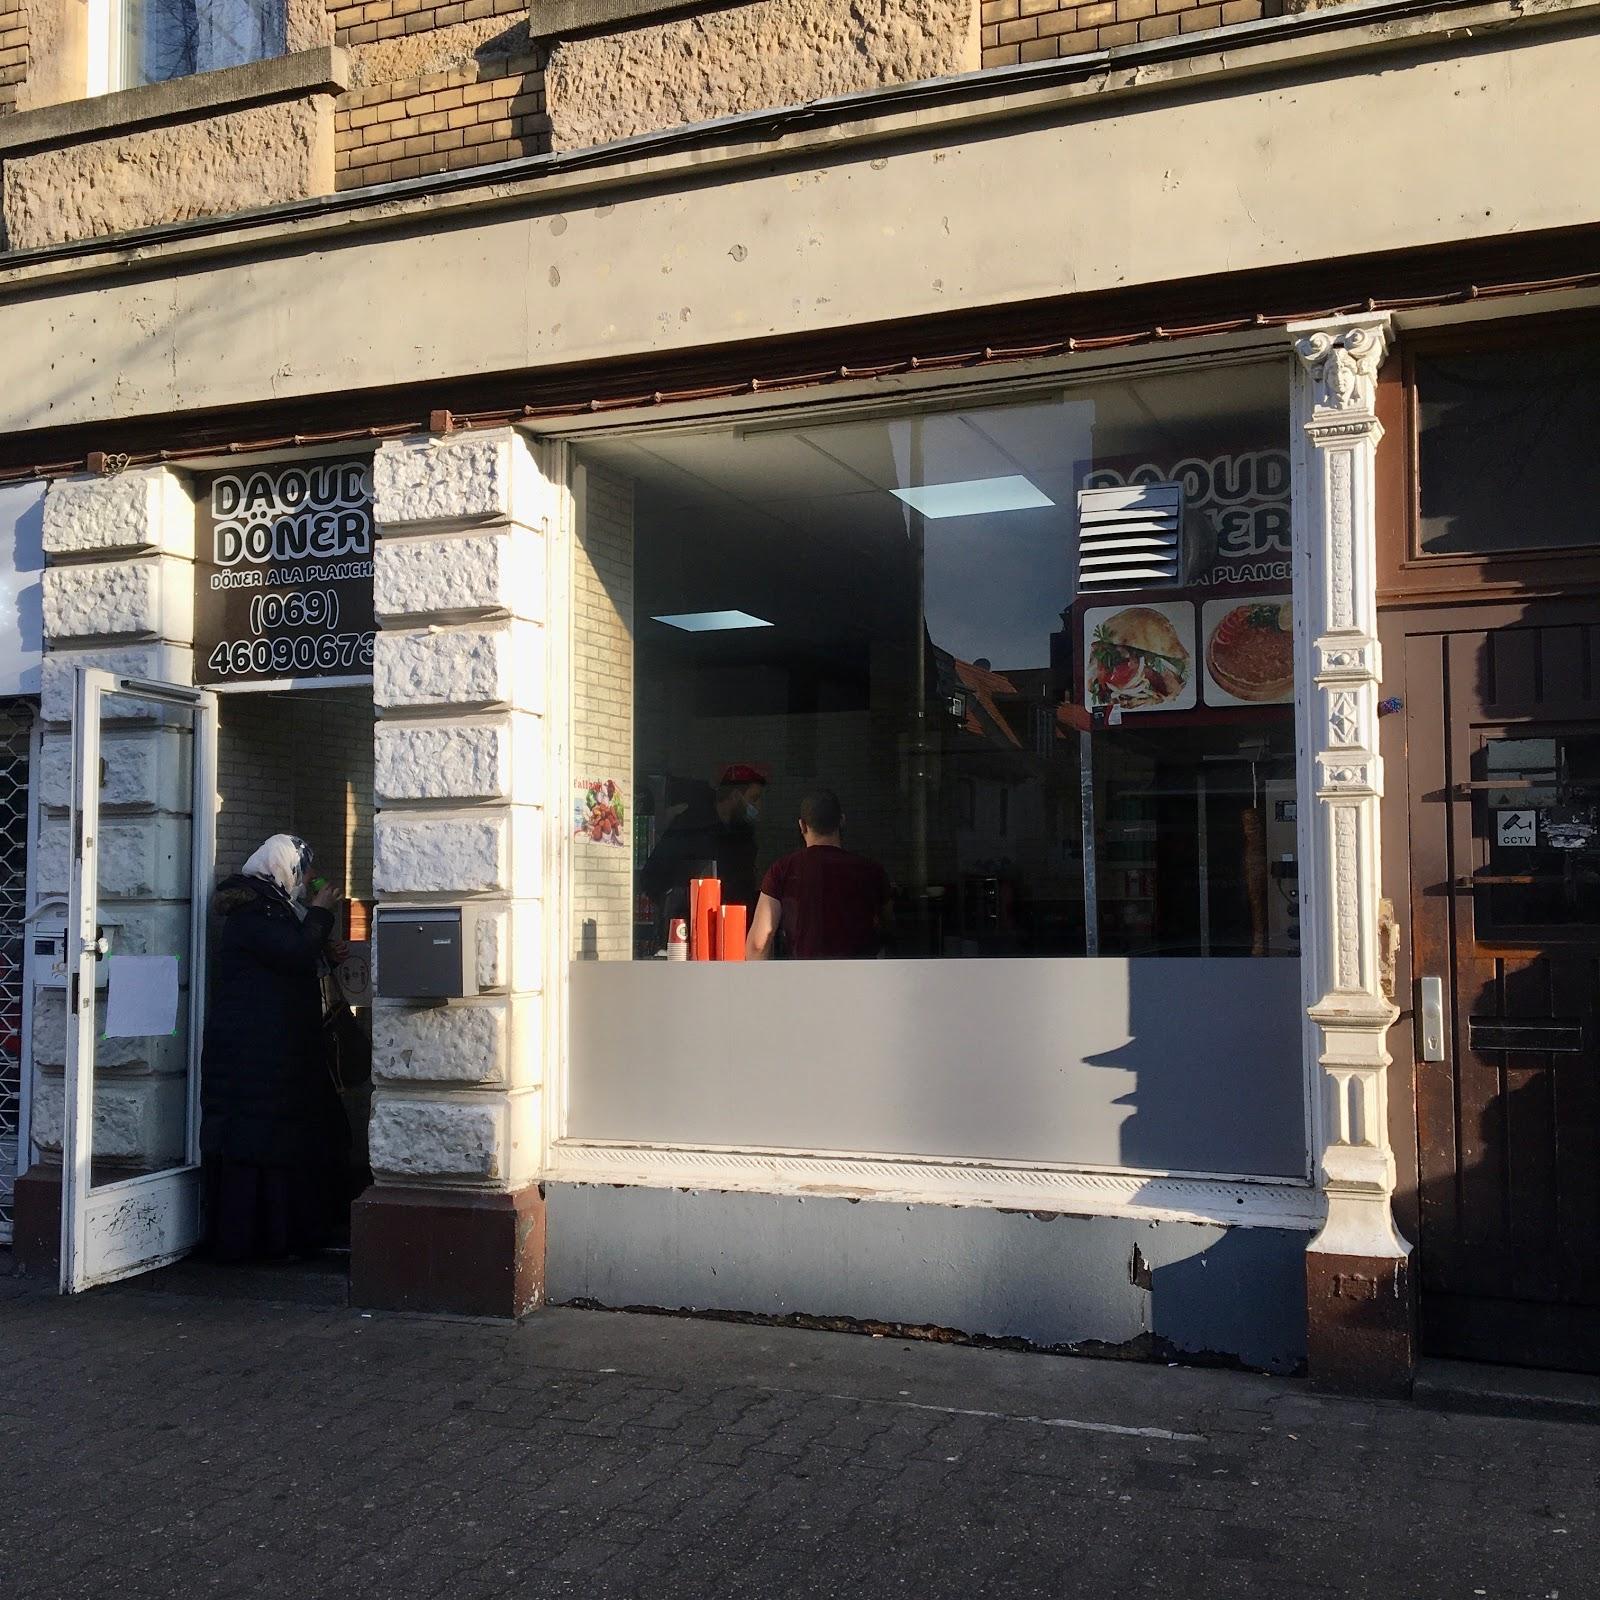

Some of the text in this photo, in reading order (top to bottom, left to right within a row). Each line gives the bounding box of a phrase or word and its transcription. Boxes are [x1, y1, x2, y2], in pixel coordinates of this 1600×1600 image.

[212, 462, 373, 520] DAOUD
[214, 508, 370, 566] DÖNER
[210, 568, 263, 590] DÖNER
[250, 589, 339, 635] (069)
[208, 631, 374, 675] 46090673
[1503, 836, 1531, 844] CCTV
